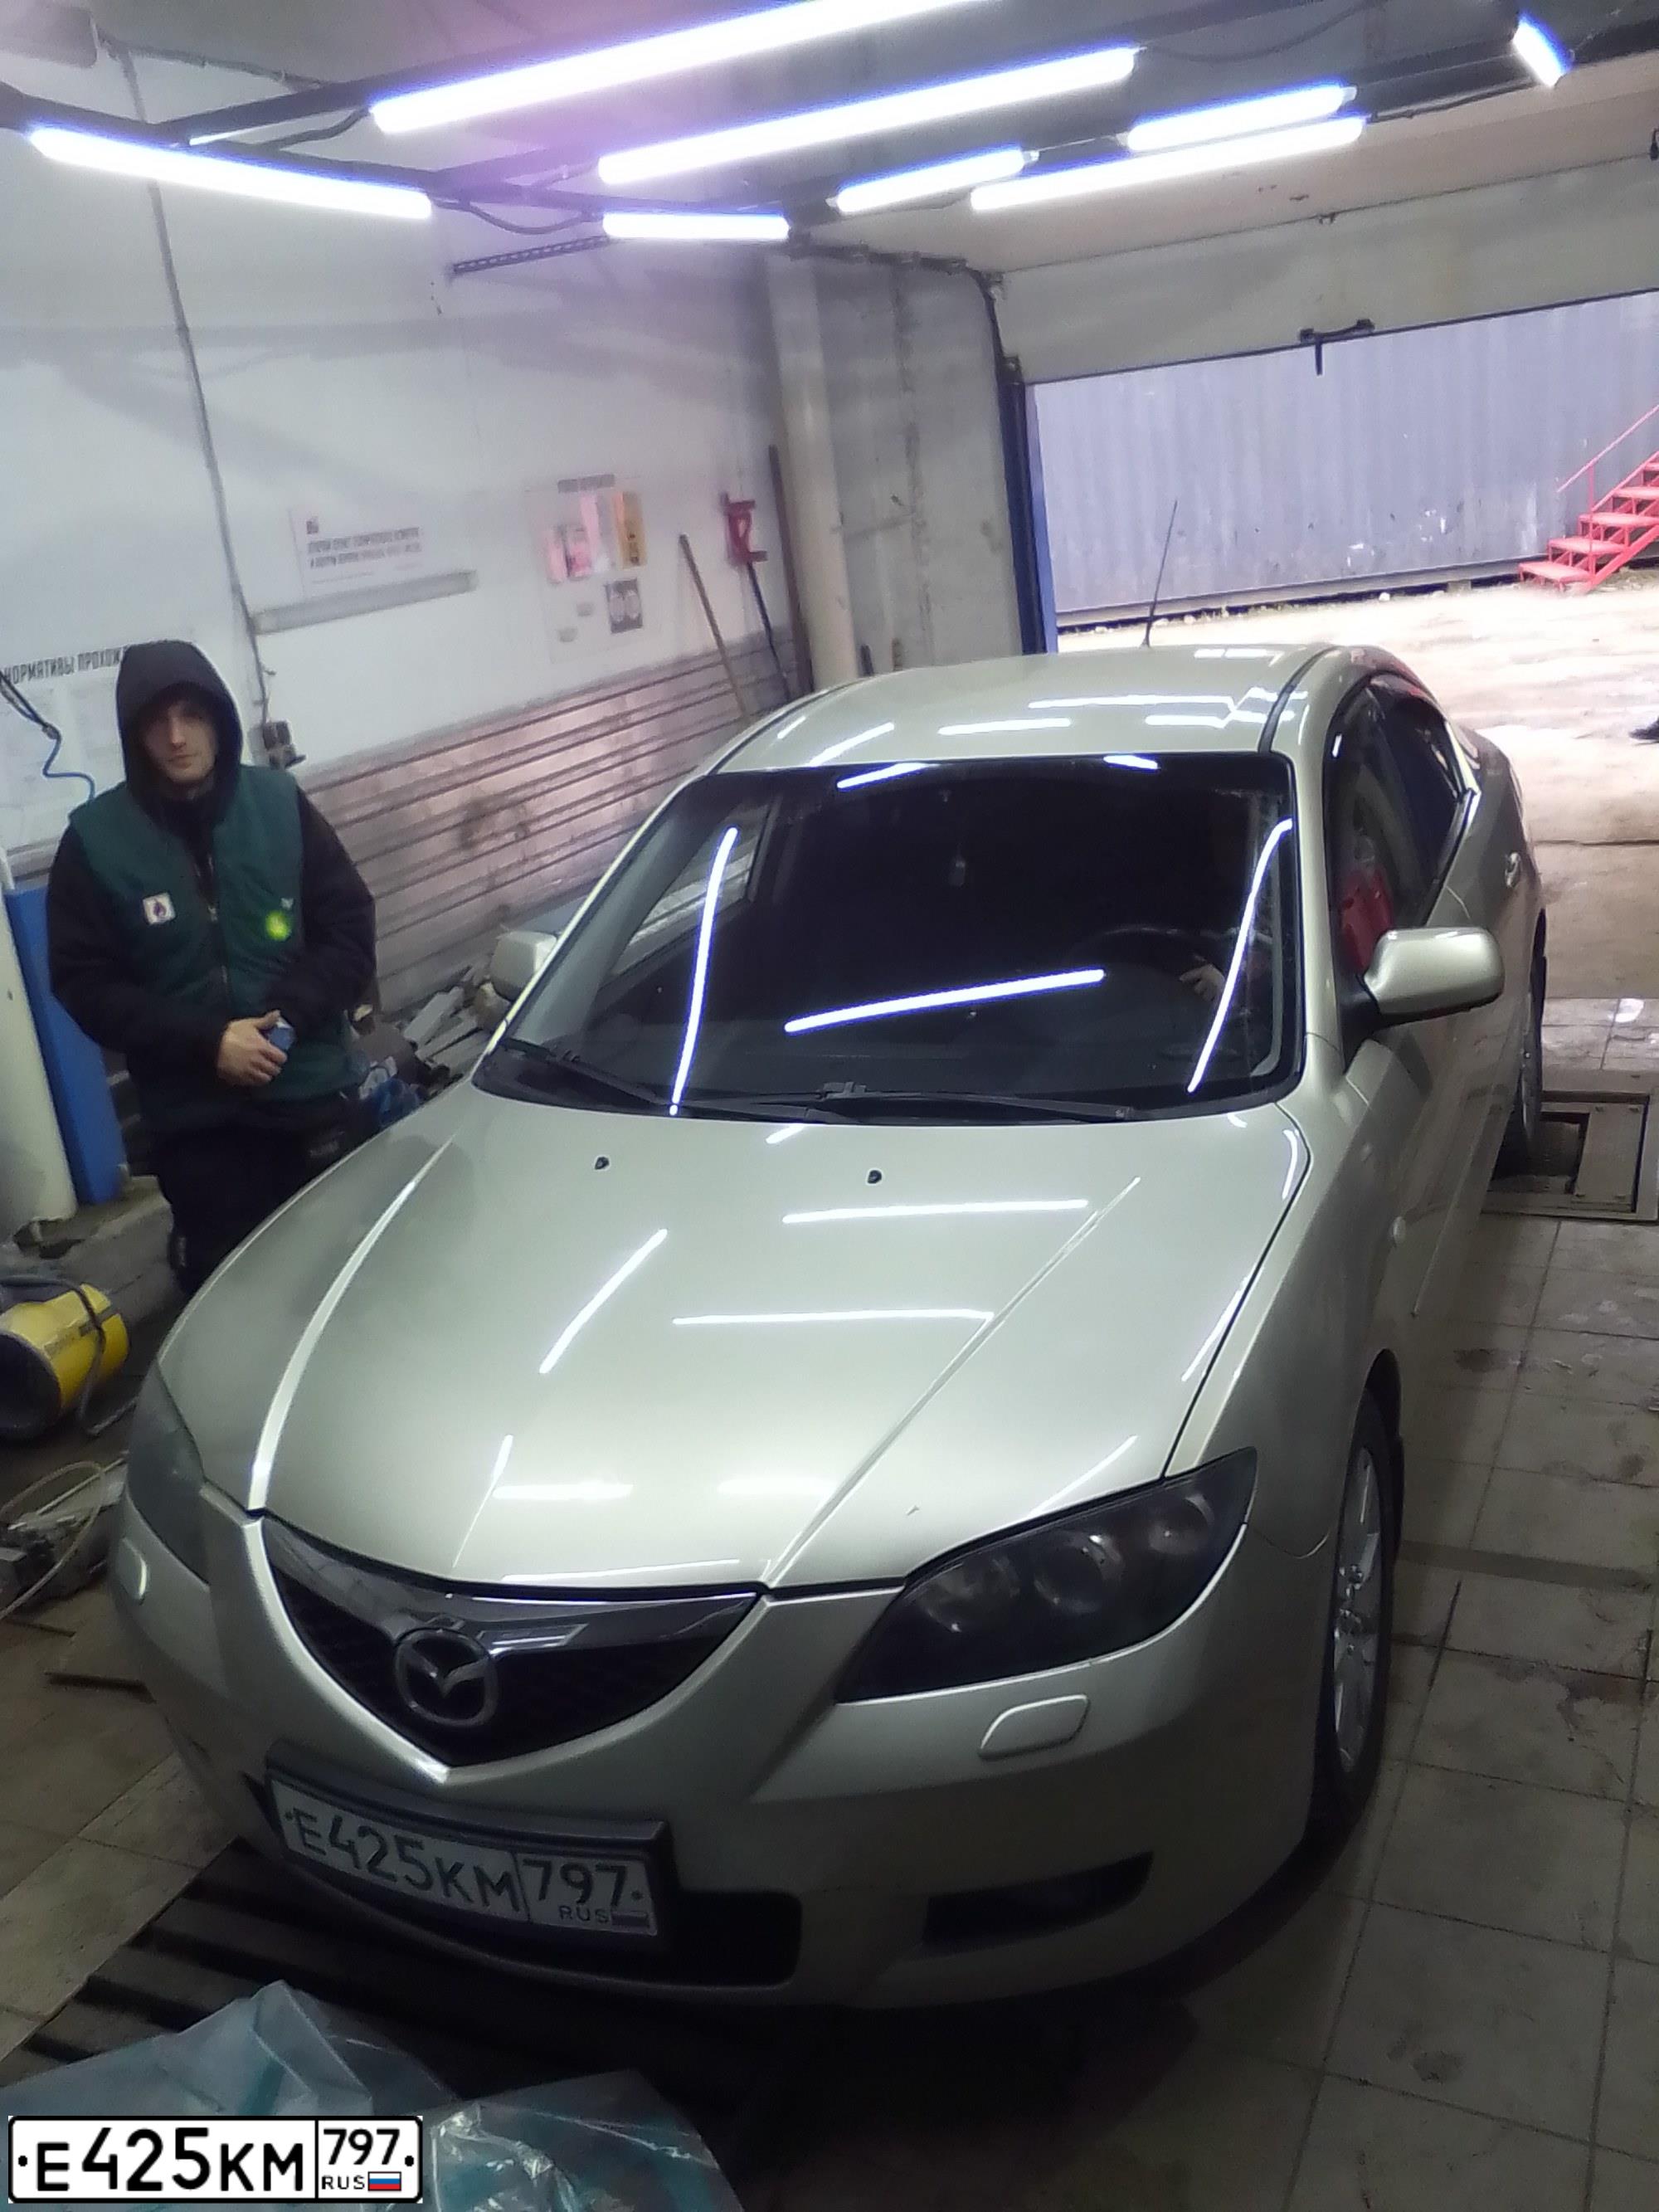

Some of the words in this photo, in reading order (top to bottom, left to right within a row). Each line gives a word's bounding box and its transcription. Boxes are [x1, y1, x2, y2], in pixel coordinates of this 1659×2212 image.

[78, 646, 129, 671] ПРОХОЖ
[293, 1806, 520, 1912] E425KM
[523, 1858, 627, 1907] 797
[558, 1904, 610, 1923] RUS
